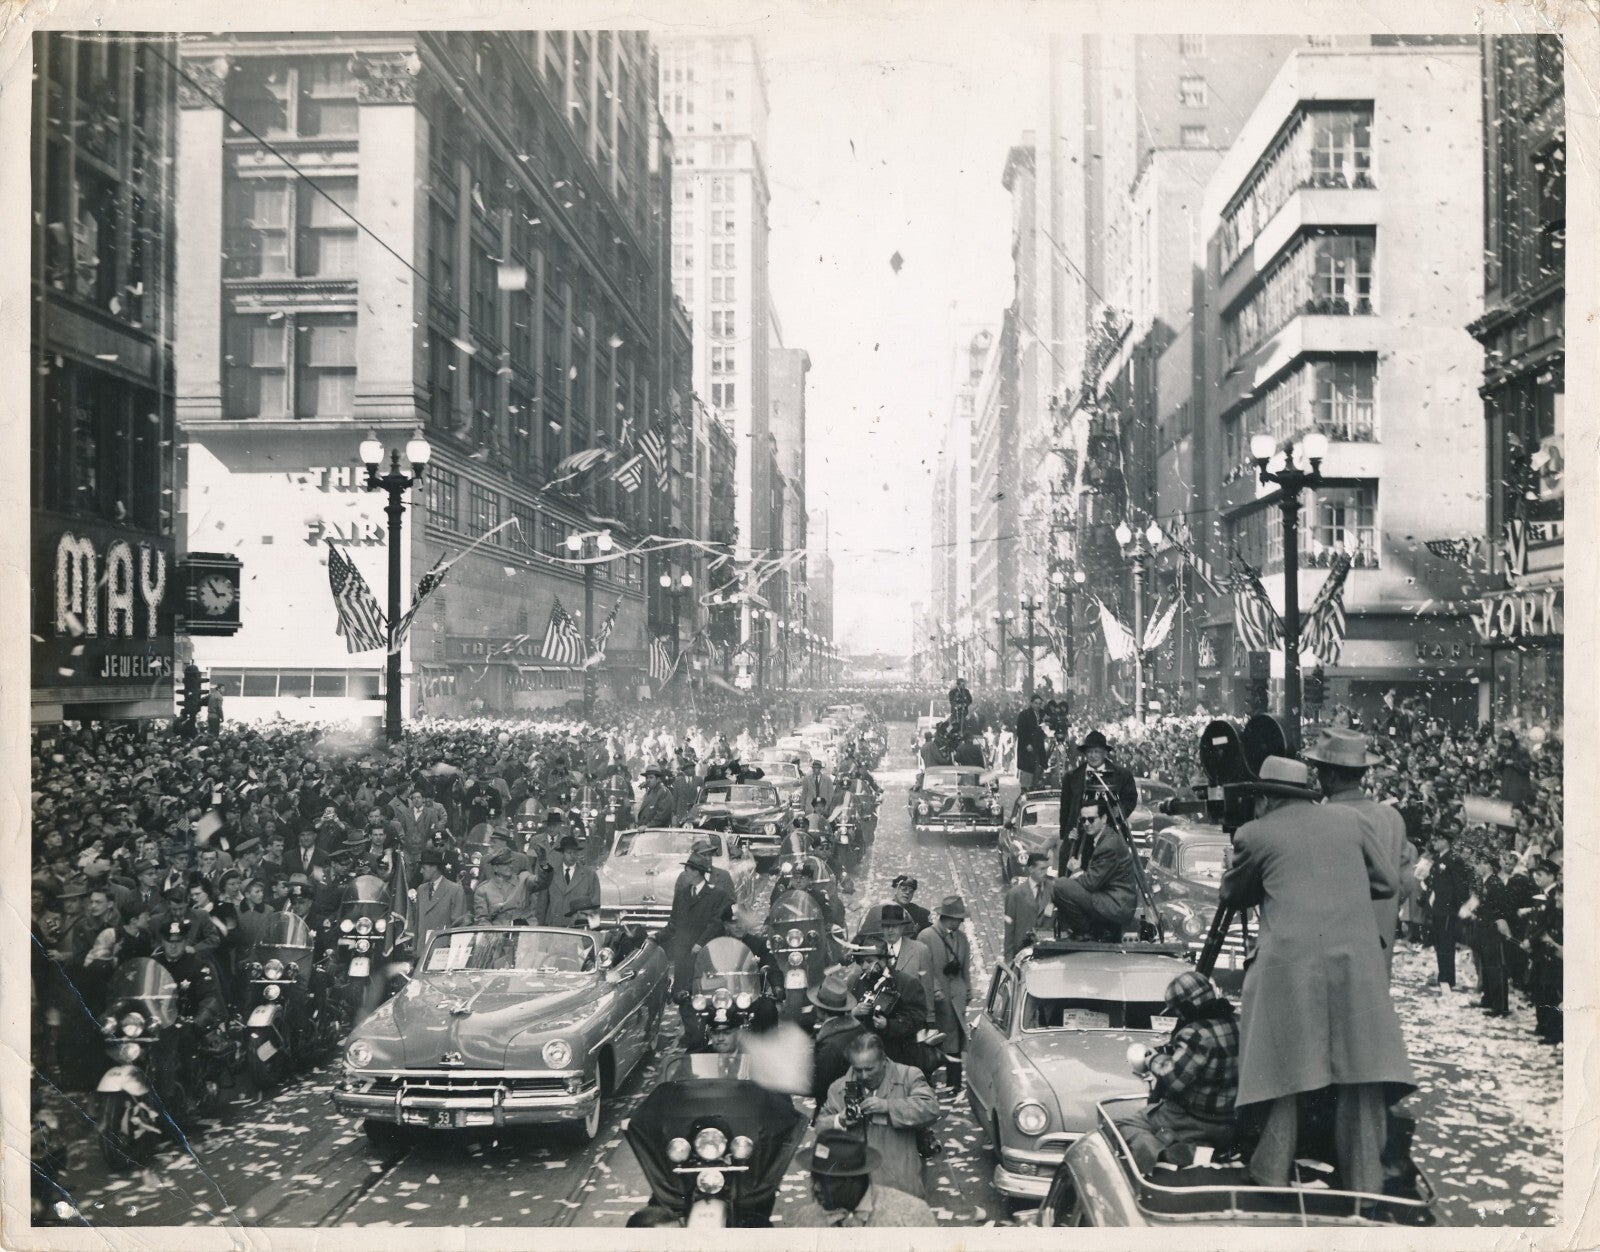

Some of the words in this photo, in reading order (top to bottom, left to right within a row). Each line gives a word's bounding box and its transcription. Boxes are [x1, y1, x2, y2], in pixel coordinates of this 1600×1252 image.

[308, 466, 371, 488] THE
[302, 520, 381, 542] FAIR
[56, 532, 167, 640] MAY
[1469, 590, 1557, 641] YORK
[461, 643, 496, 655] THE
[100, 654, 172, 678] JEWELERS
[438, 1111, 450, 1124] 53
